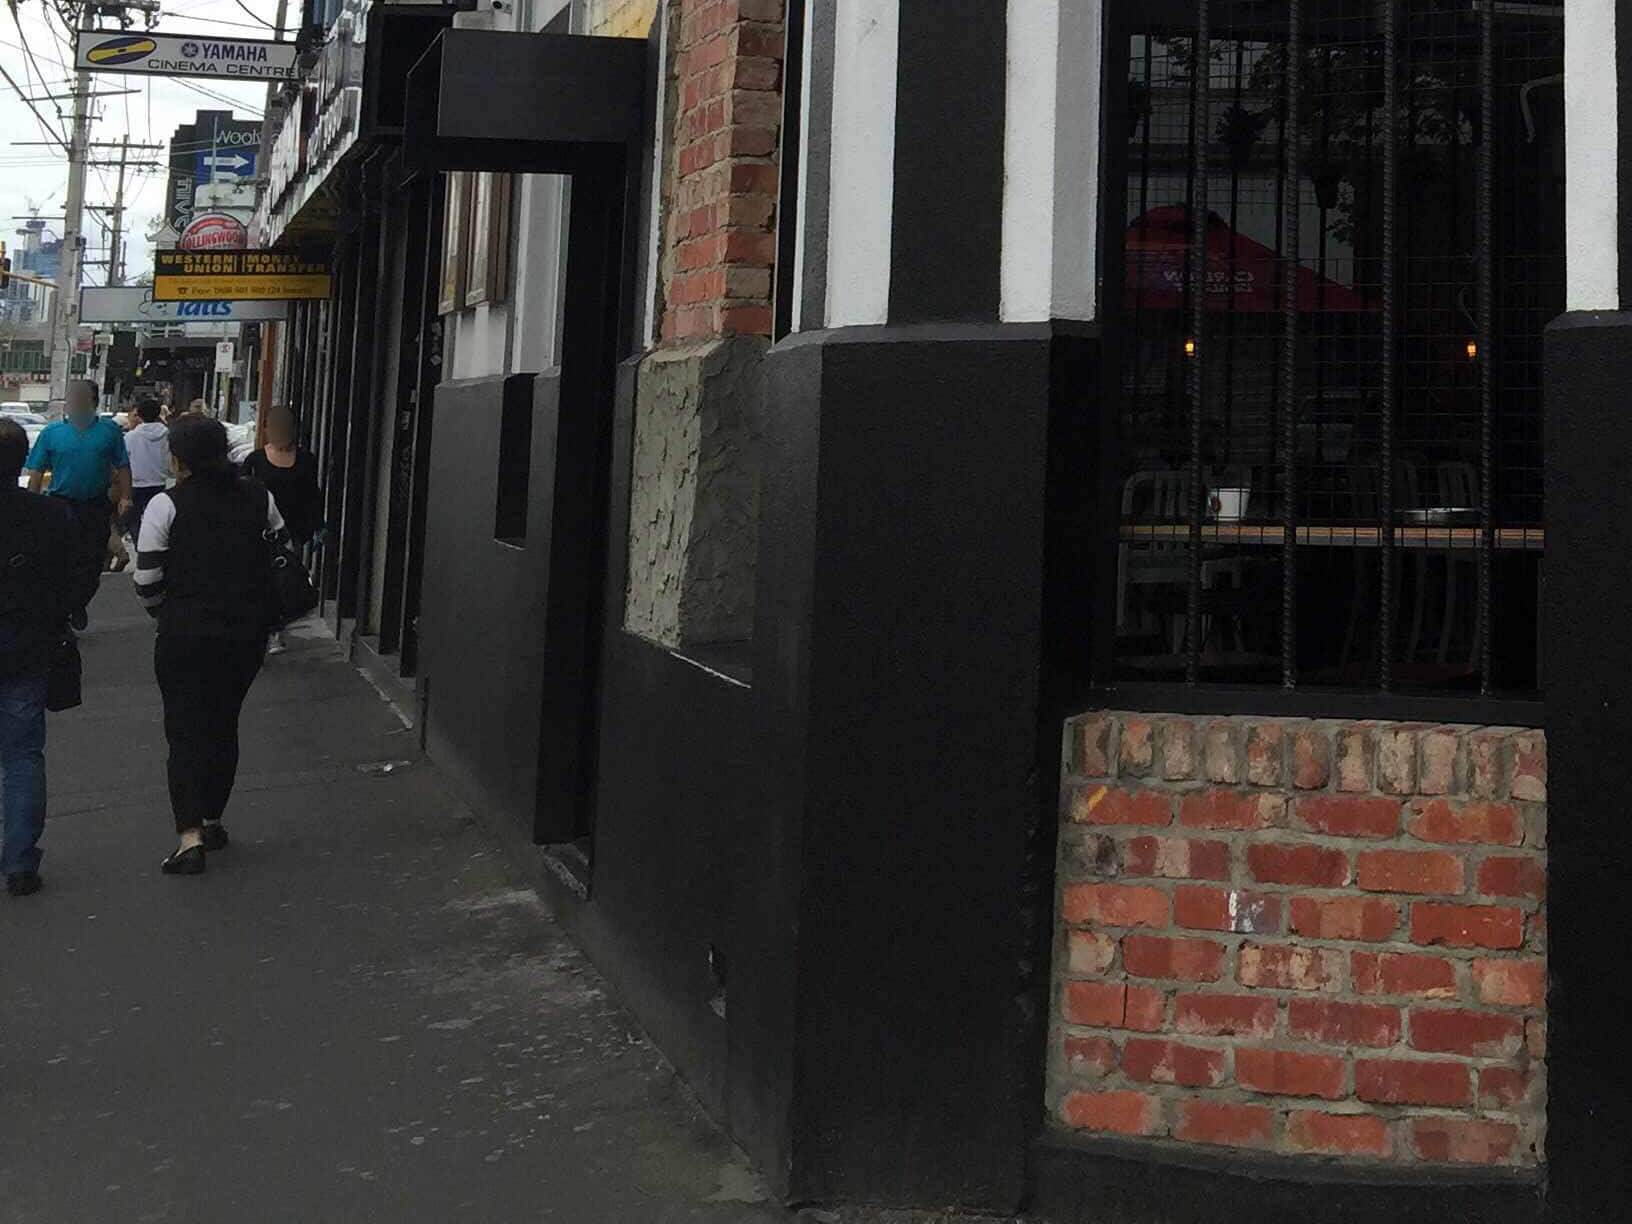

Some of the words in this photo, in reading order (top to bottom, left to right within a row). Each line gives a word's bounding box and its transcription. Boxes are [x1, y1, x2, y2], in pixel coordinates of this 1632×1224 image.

[202, 43, 268, 62] YAMAHA
[148, 59, 218, 72] CINEMA
[226, 63, 297, 76] CENTRE
[161, 255, 233, 264] WESTERN
[184, 264, 233, 273] UNION
